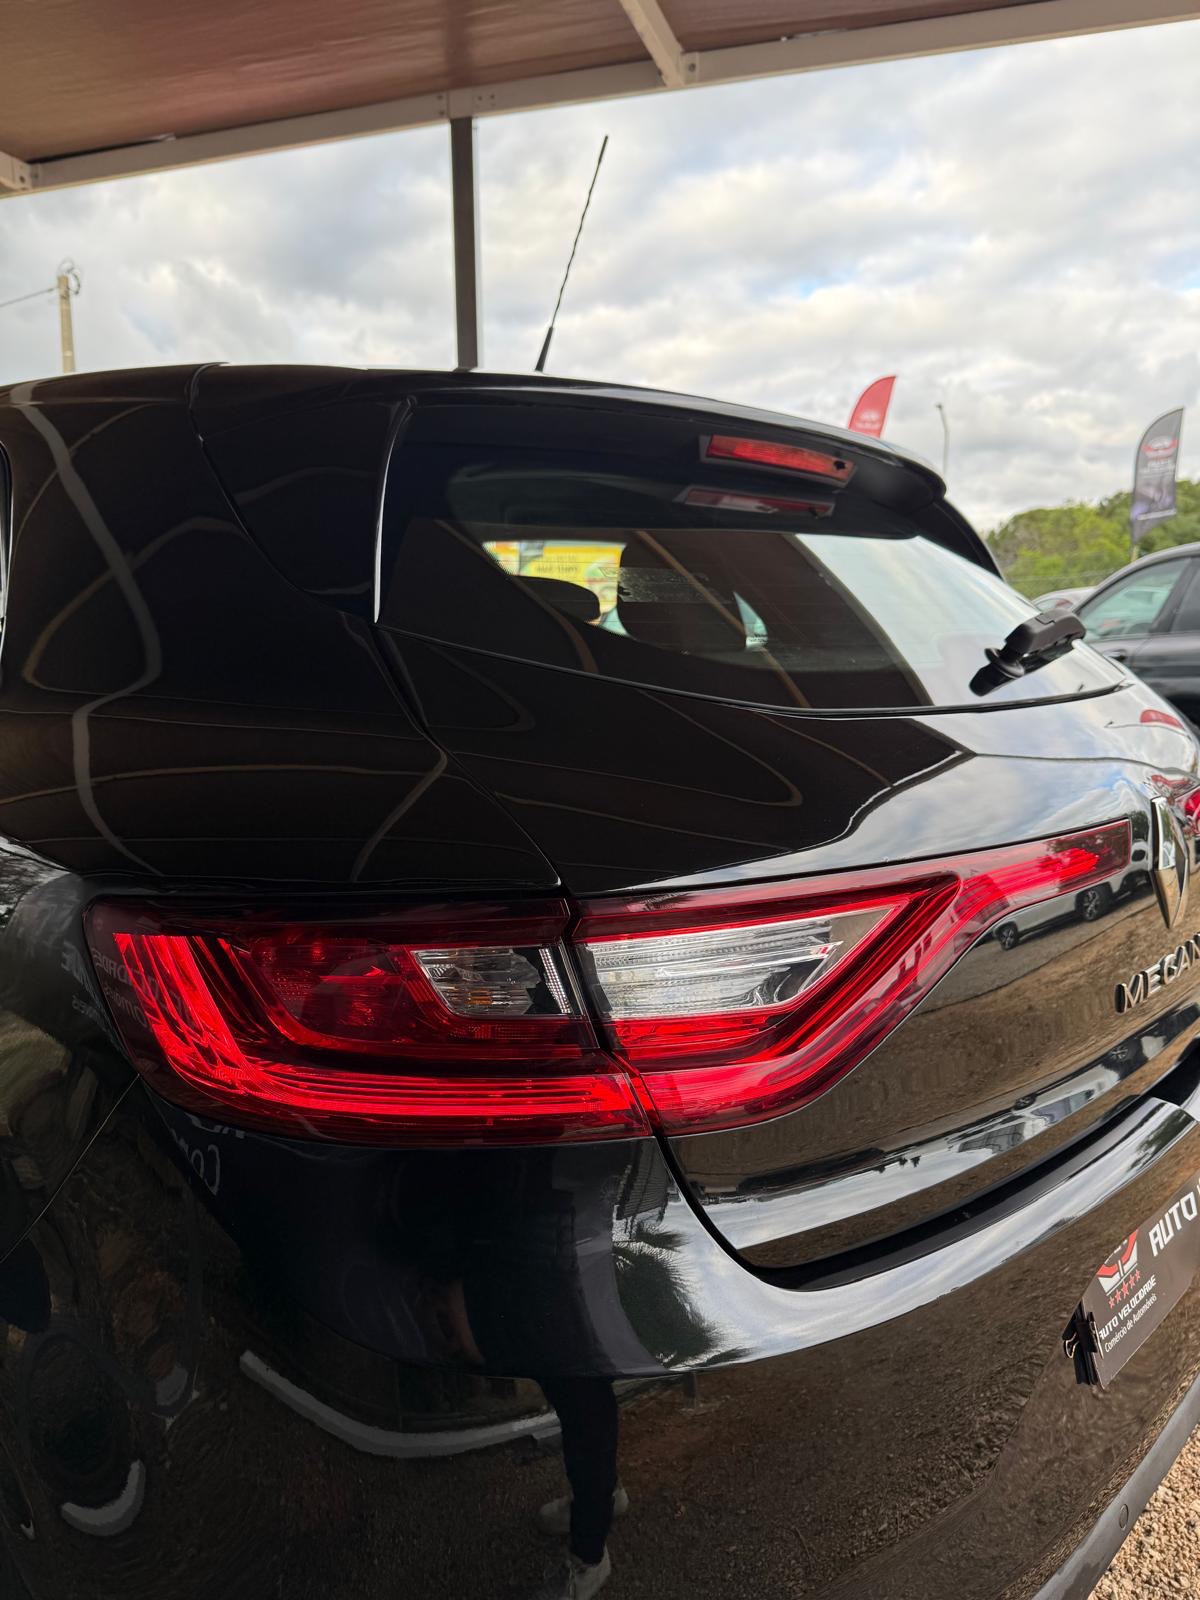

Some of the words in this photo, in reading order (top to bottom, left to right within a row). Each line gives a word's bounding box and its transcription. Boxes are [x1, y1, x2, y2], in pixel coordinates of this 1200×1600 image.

[1149, 1191, 1198, 1257] AUTO
[1104, 1326, 1128, 1353] Comércio
[1126, 1319, 1134, 1331] de
[1133, 1293, 1158, 1324] Automóveis
[1118, 1274, 1157, 1320] VELOCIDADE
